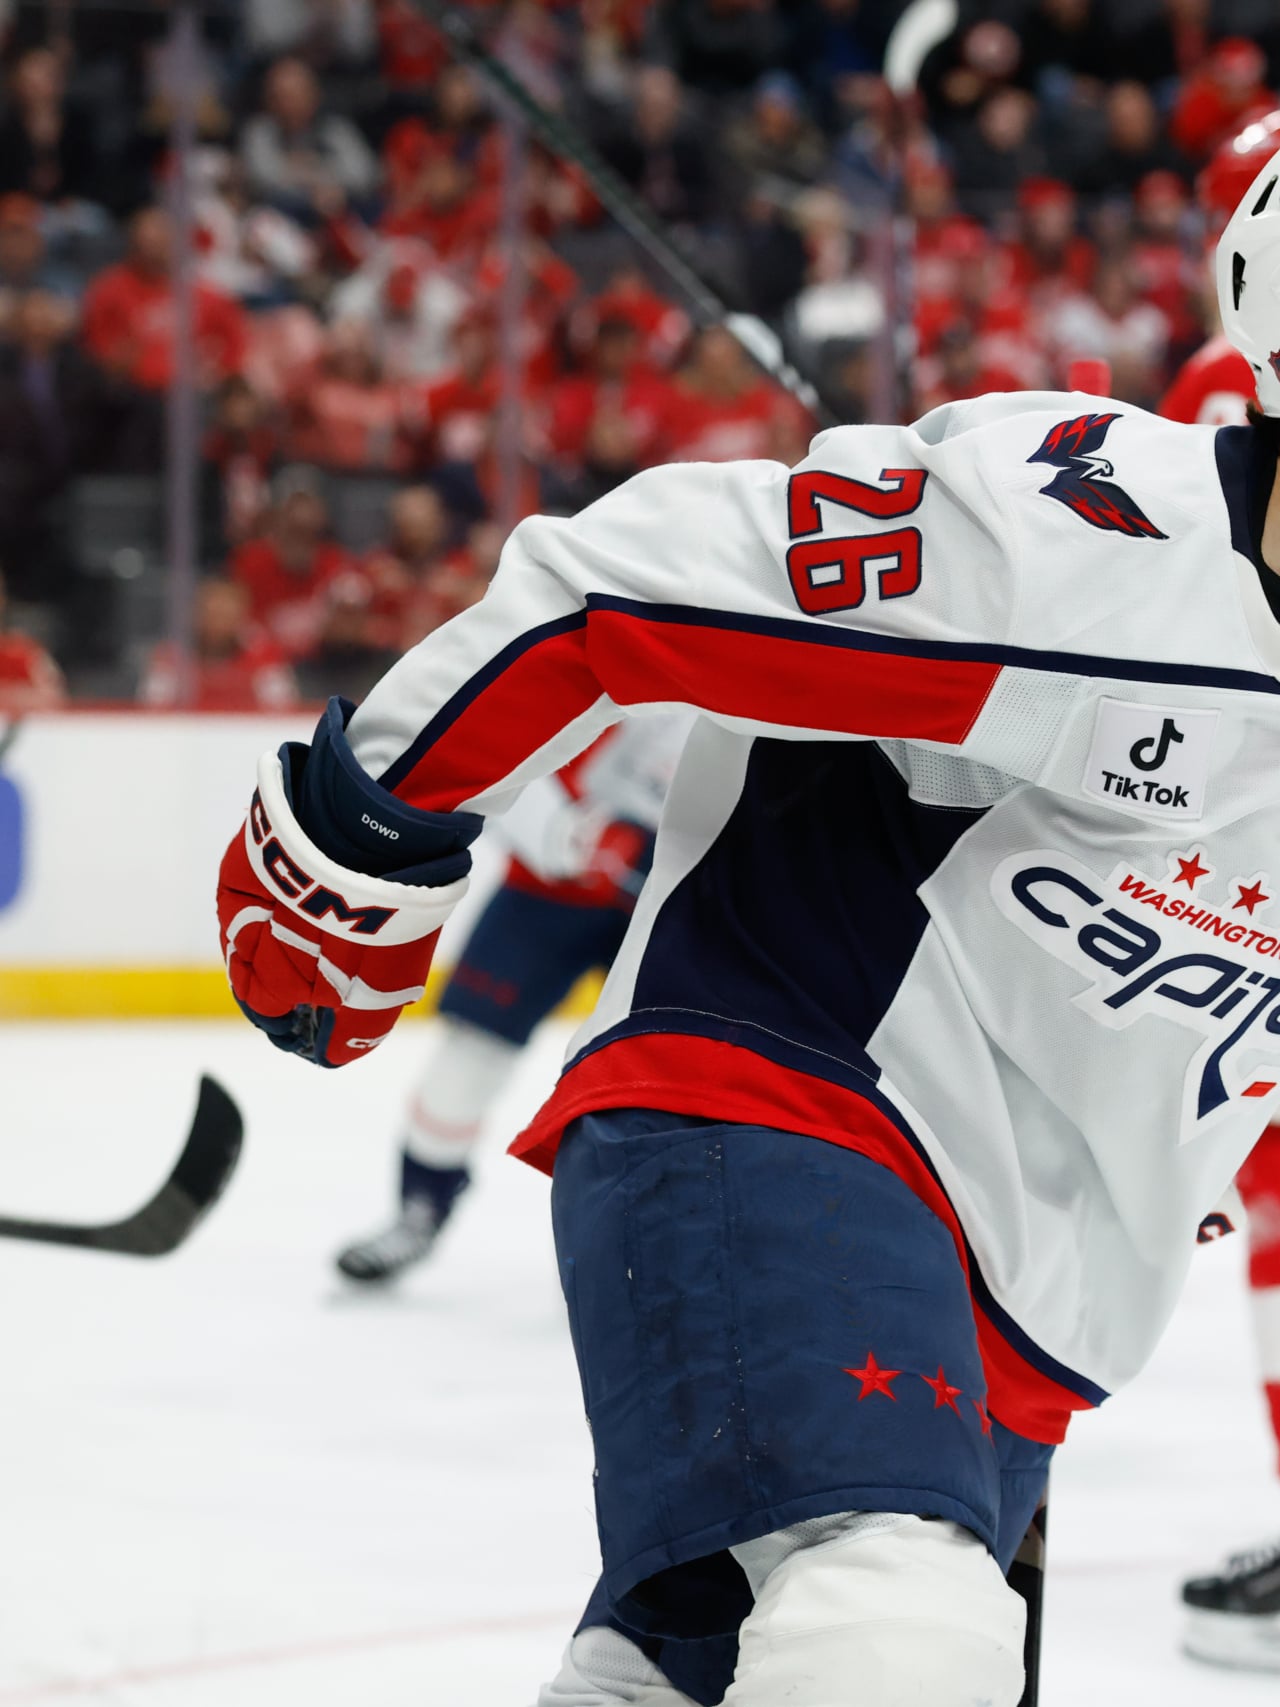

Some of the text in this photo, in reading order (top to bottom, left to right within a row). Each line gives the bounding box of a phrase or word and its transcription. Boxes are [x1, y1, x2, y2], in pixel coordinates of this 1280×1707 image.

[786, 468, 929, 616] 26
[361, 813, 400, 840] DOWD
[1102, 770, 1190, 807] TikTok
[250, 786, 400, 935] CCM
